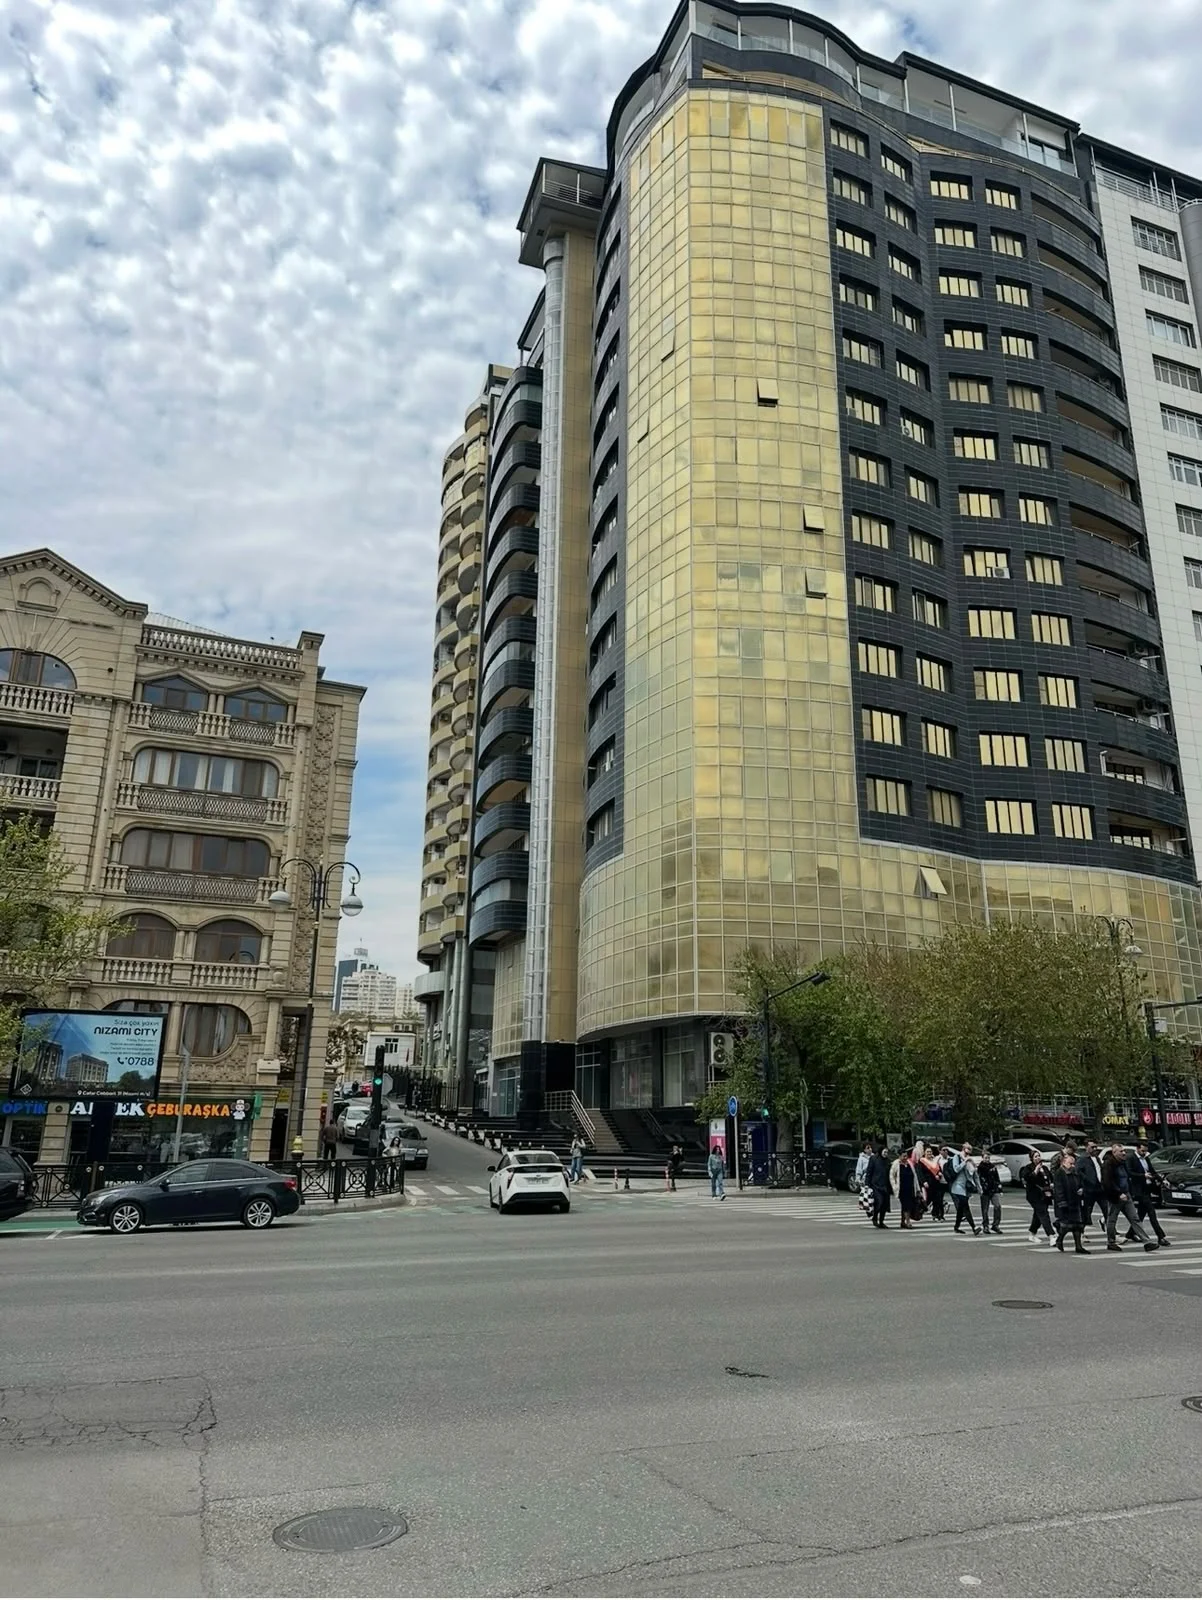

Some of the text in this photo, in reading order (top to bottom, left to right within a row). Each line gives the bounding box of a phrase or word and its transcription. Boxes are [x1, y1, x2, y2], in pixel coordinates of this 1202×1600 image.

[94, 1026, 158, 1036] NIZAMI CITY
[70, 1101, 230, 1119] AEK ÇEBURAŞKA
